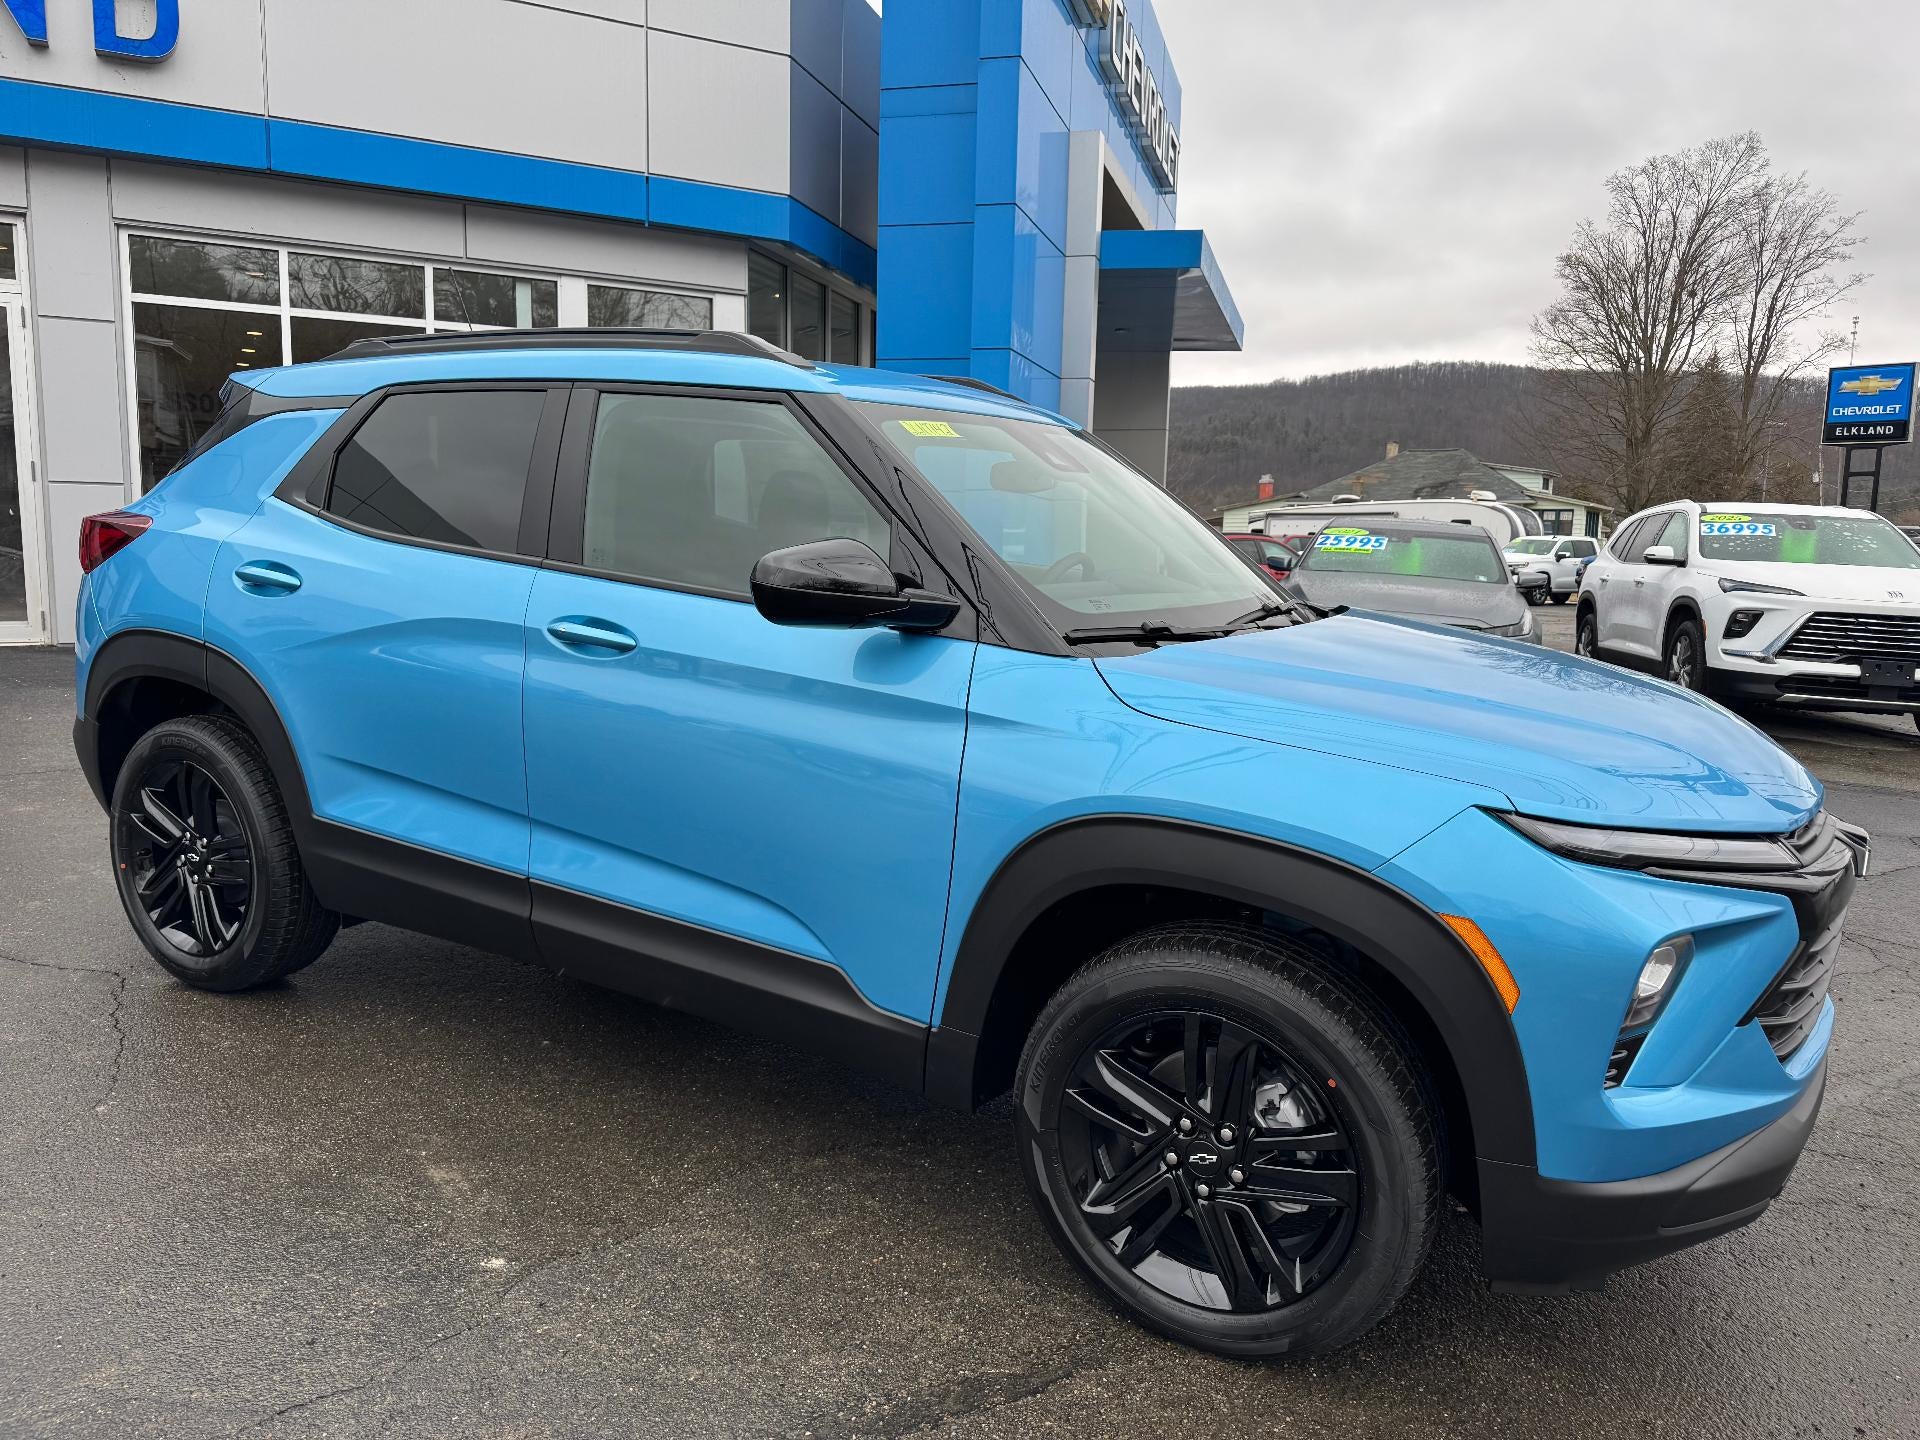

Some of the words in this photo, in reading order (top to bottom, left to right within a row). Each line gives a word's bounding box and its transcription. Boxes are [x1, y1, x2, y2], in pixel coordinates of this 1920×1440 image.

[1832, 404, 1902, 416] CHEVROLET
[1836, 425, 1894, 436] ELKLAND
[1703, 523, 1773, 534] 36995
[1316, 536, 1385, 548] 25995
